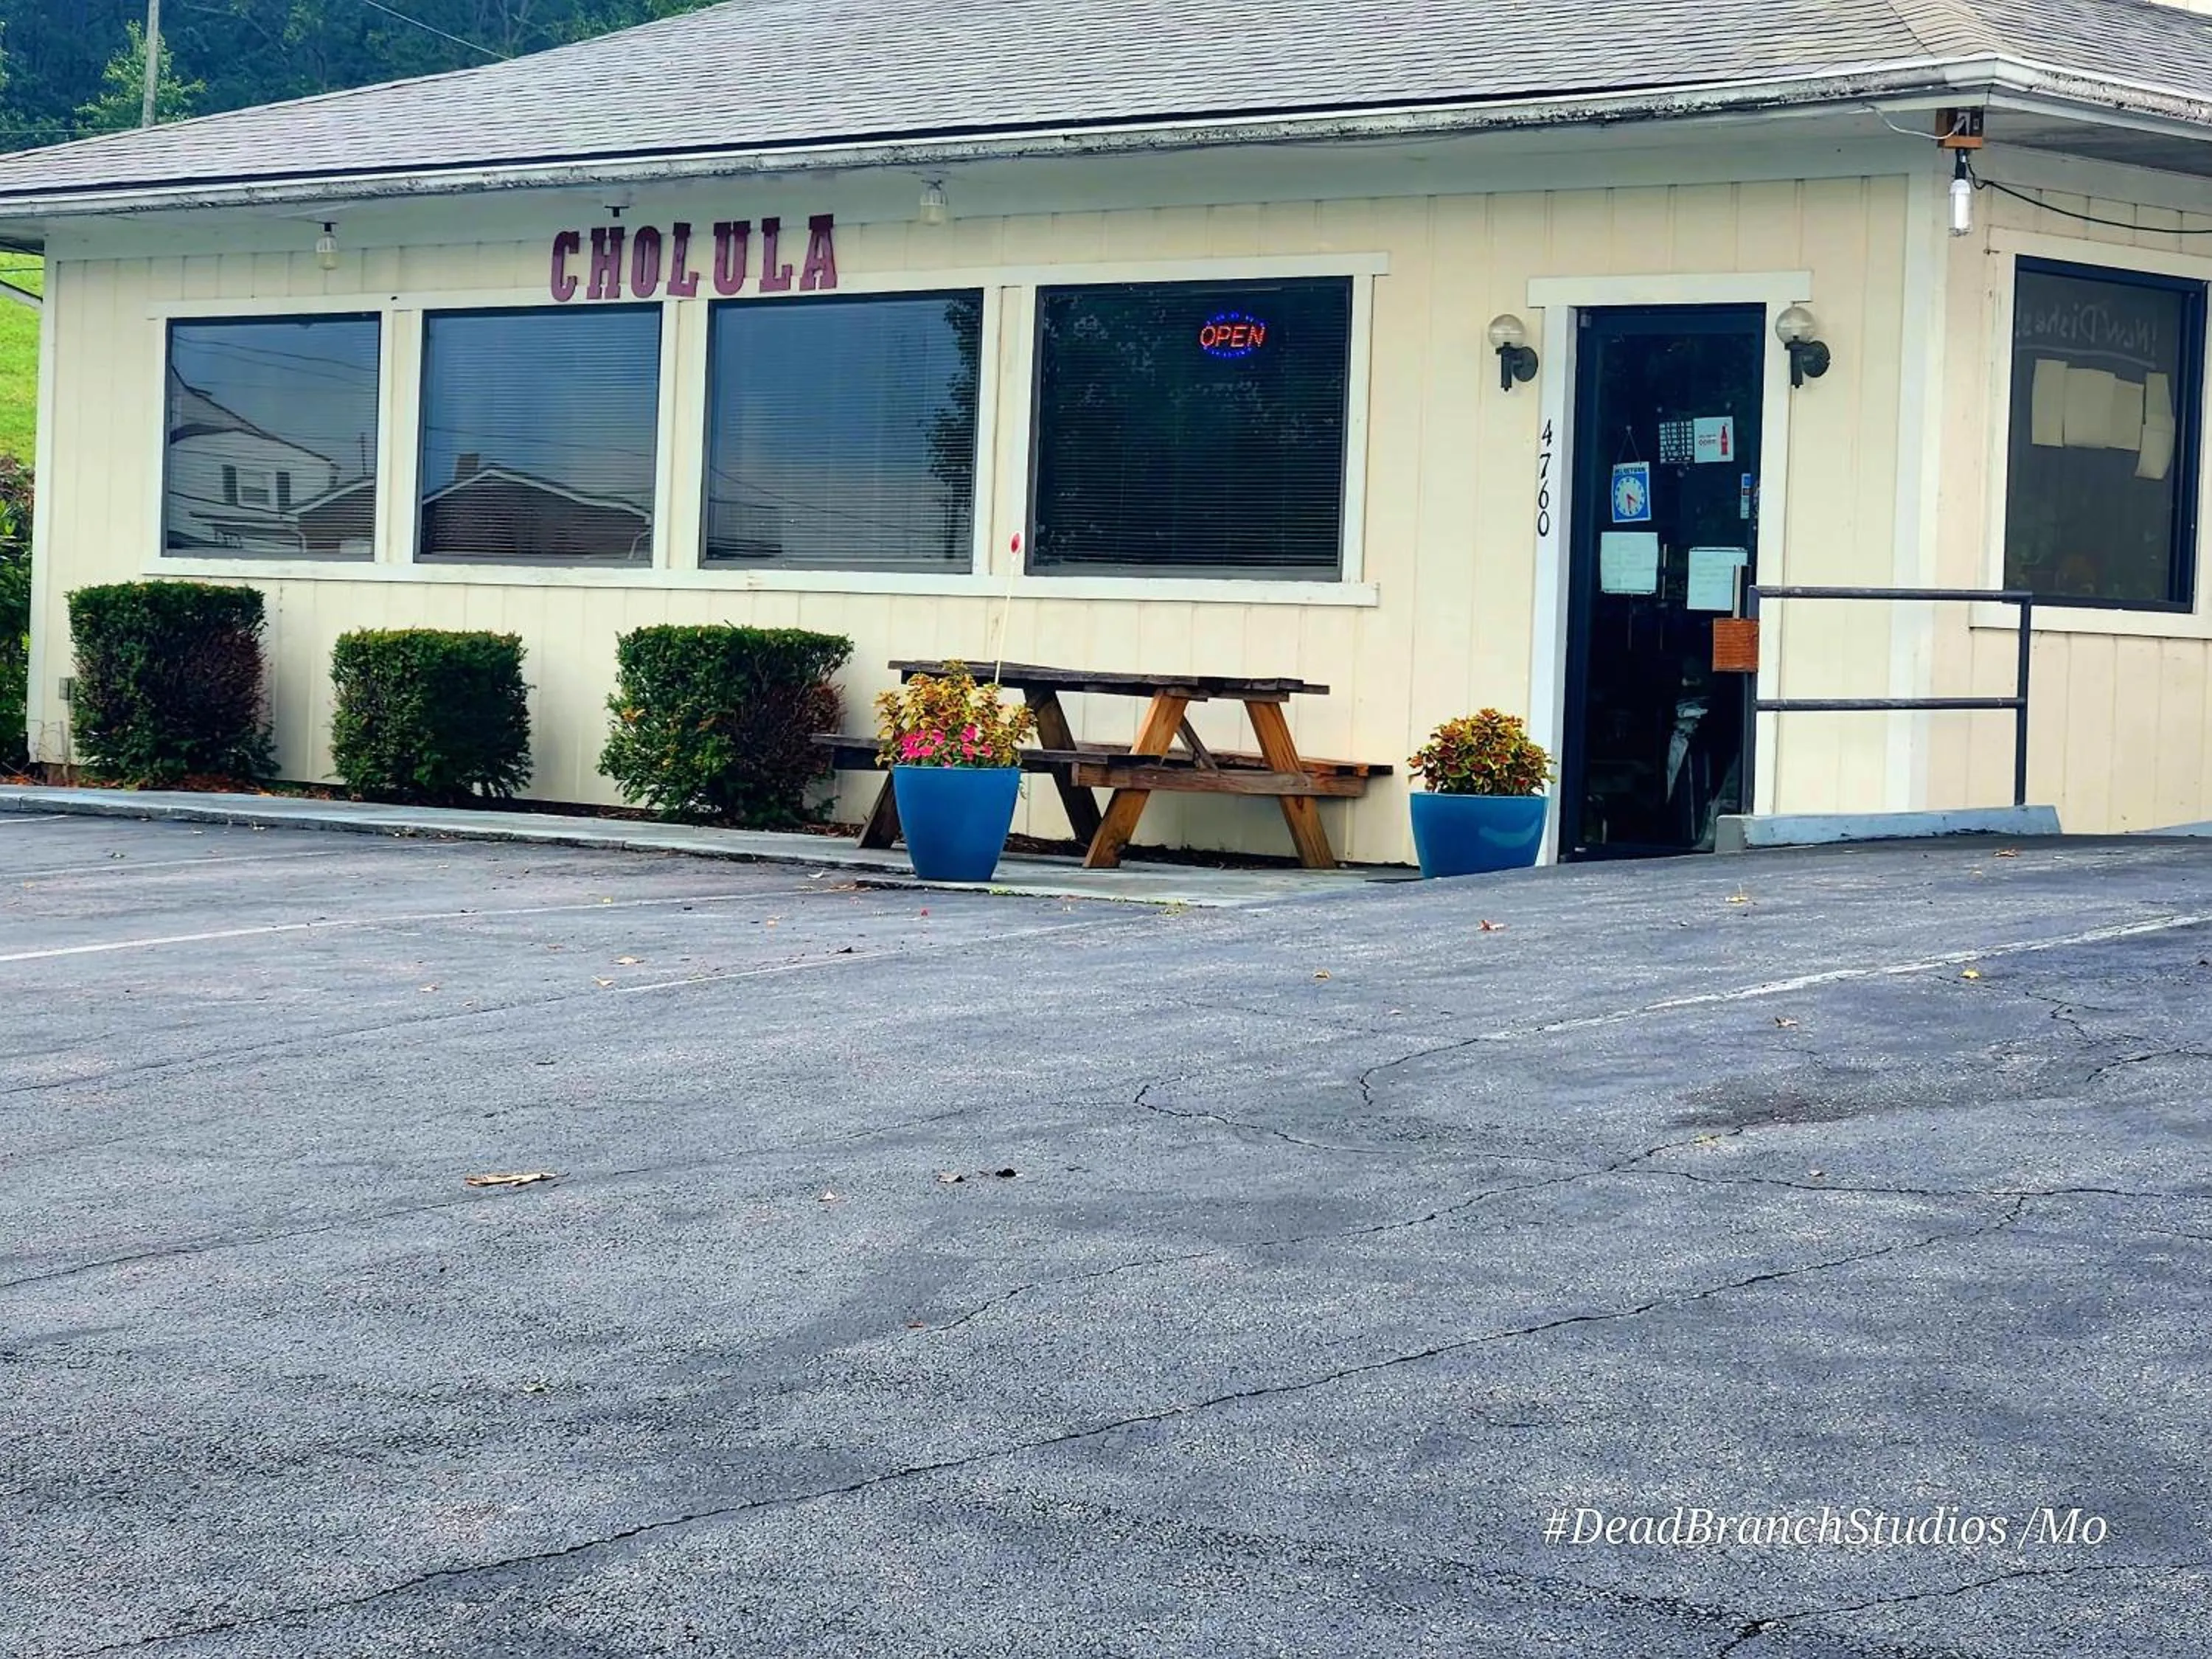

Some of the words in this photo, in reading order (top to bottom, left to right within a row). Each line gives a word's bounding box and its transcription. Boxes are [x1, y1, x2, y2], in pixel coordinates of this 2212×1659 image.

[551, 214, 838, 302] CHOLULA
[1200, 325, 1265, 347] OPEN
[1537, 418, 1554, 538] 4760
